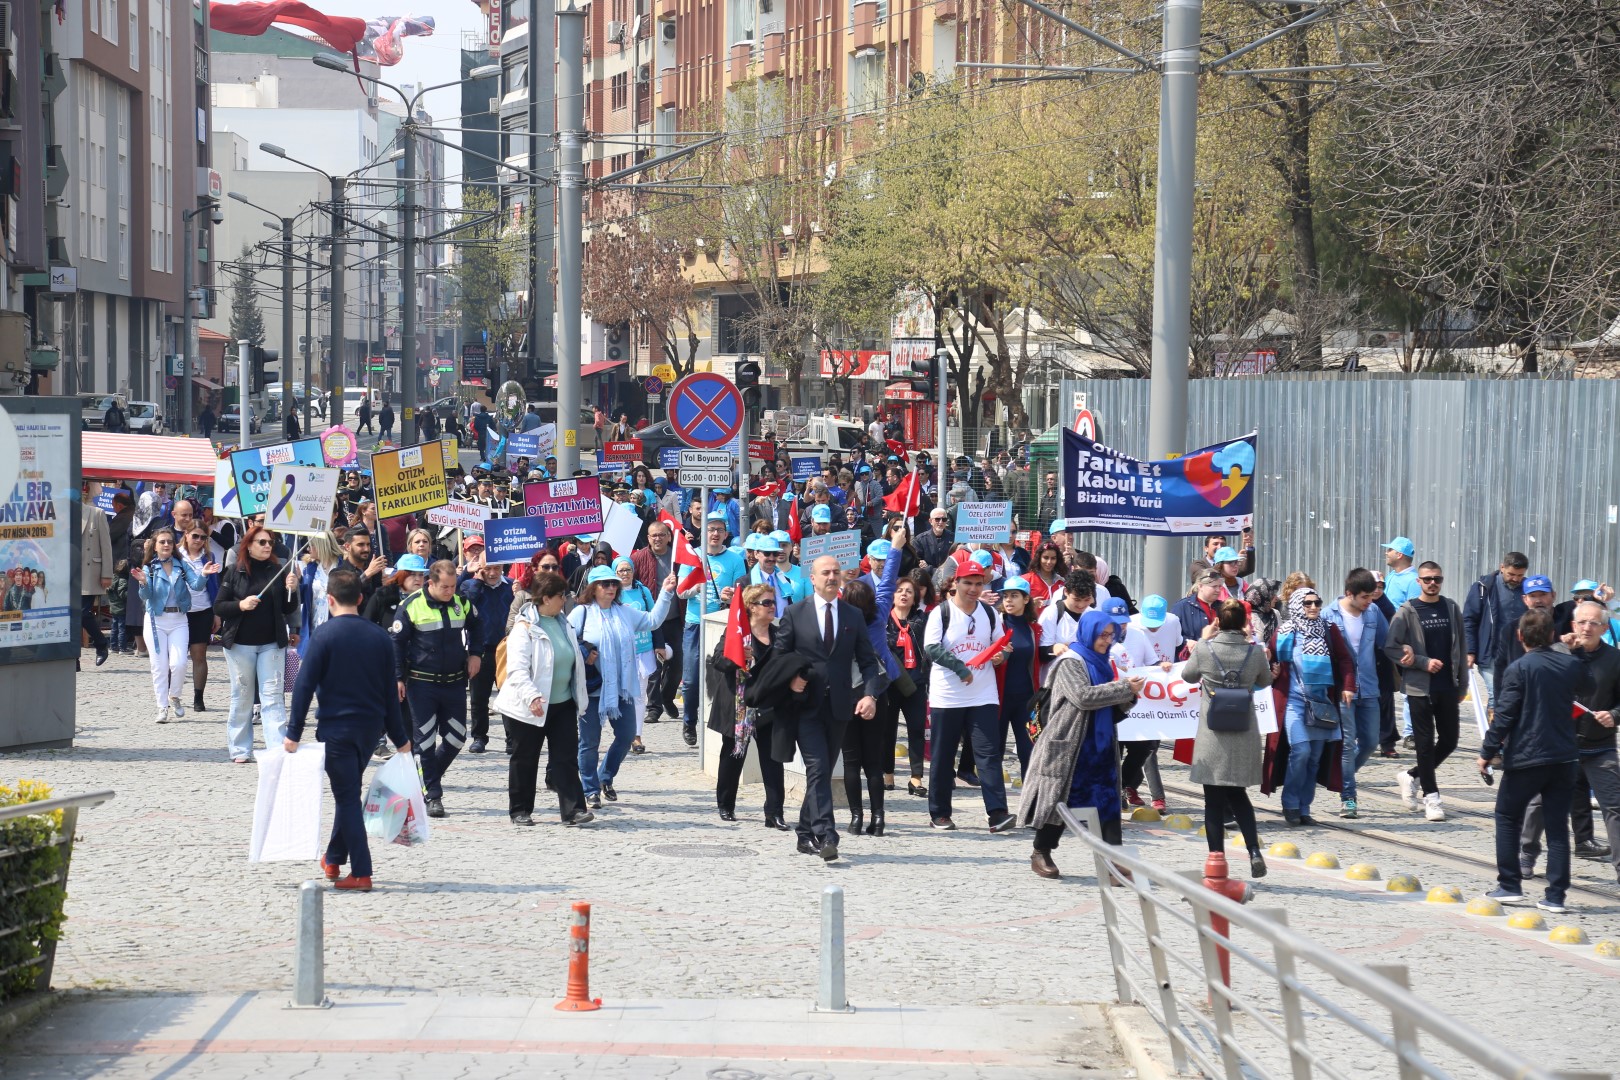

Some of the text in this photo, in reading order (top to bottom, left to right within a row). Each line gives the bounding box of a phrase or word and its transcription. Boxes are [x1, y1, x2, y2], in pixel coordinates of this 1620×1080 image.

[1075, 394, 1085, 402] WC
[612, 443, 635, 451] OTİZMİN
[684, 454, 696, 462] Yol
[697, 454, 728, 464] Boyunca
[1078, 450, 1161, 477] Fark Et
[397, 466, 425, 481] OTİZM
[682, 473, 703, 482] 05:00
[708, 474, 729, 483] 01:00
[378, 473, 444, 497] EKSİKLİK DEĞİL,
[1077, 470, 1162, 494] Kabul Et
[27, 481, 52, 501] BİR
[382, 489, 444, 511] FARKLILIKTIR!
[1077, 491, 1162, 508] Bizimle Yürü
[527, 497, 601, 516] OTİZMLİYİM,
[430, 513, 449, 524] SEVGİ
[551, 512, 601, 528] DE VARIM!
[11, 527, 31, 538] NİSAN
[31, 526, 47, 537] 2019
[503, 527, 527, 536] OTİZM
[503, 534, 538, 545] doğumda
[493, 542, 545, 554] görülmektedir
[1127, 711, 1155, 719] Kocaeli
[1157, 711, 1188, 719] Otizmli
